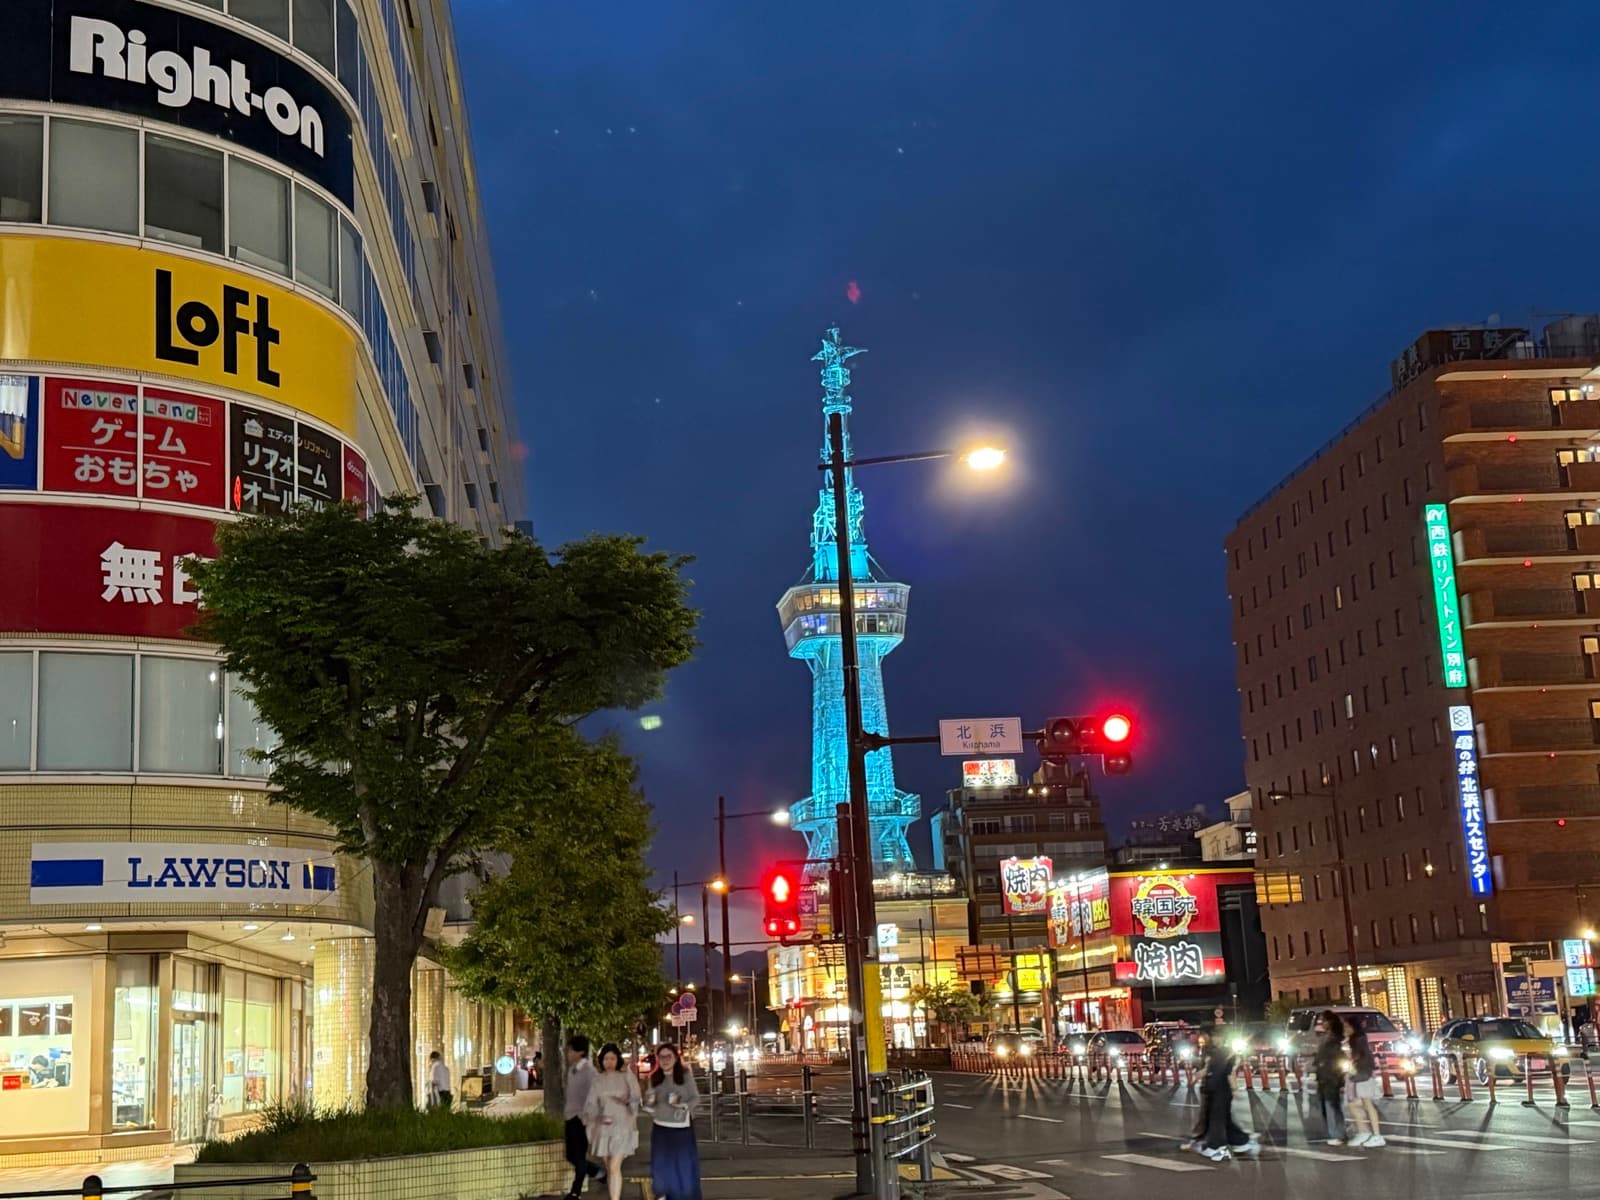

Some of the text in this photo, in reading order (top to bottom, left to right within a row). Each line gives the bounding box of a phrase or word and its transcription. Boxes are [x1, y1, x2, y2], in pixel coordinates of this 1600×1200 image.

[70, 15, 324, 158] Right-on
[91, 417, 187, 455] ゲーム
[75, 454, 198, 493] おもちゃ
[243, 441, 328, 489] リフォーム
[957, 723, 1006, 740] 北浜
[128, 857, 290, 889] LAWSON
[1135, 941, 1203, 980] 焼肉
